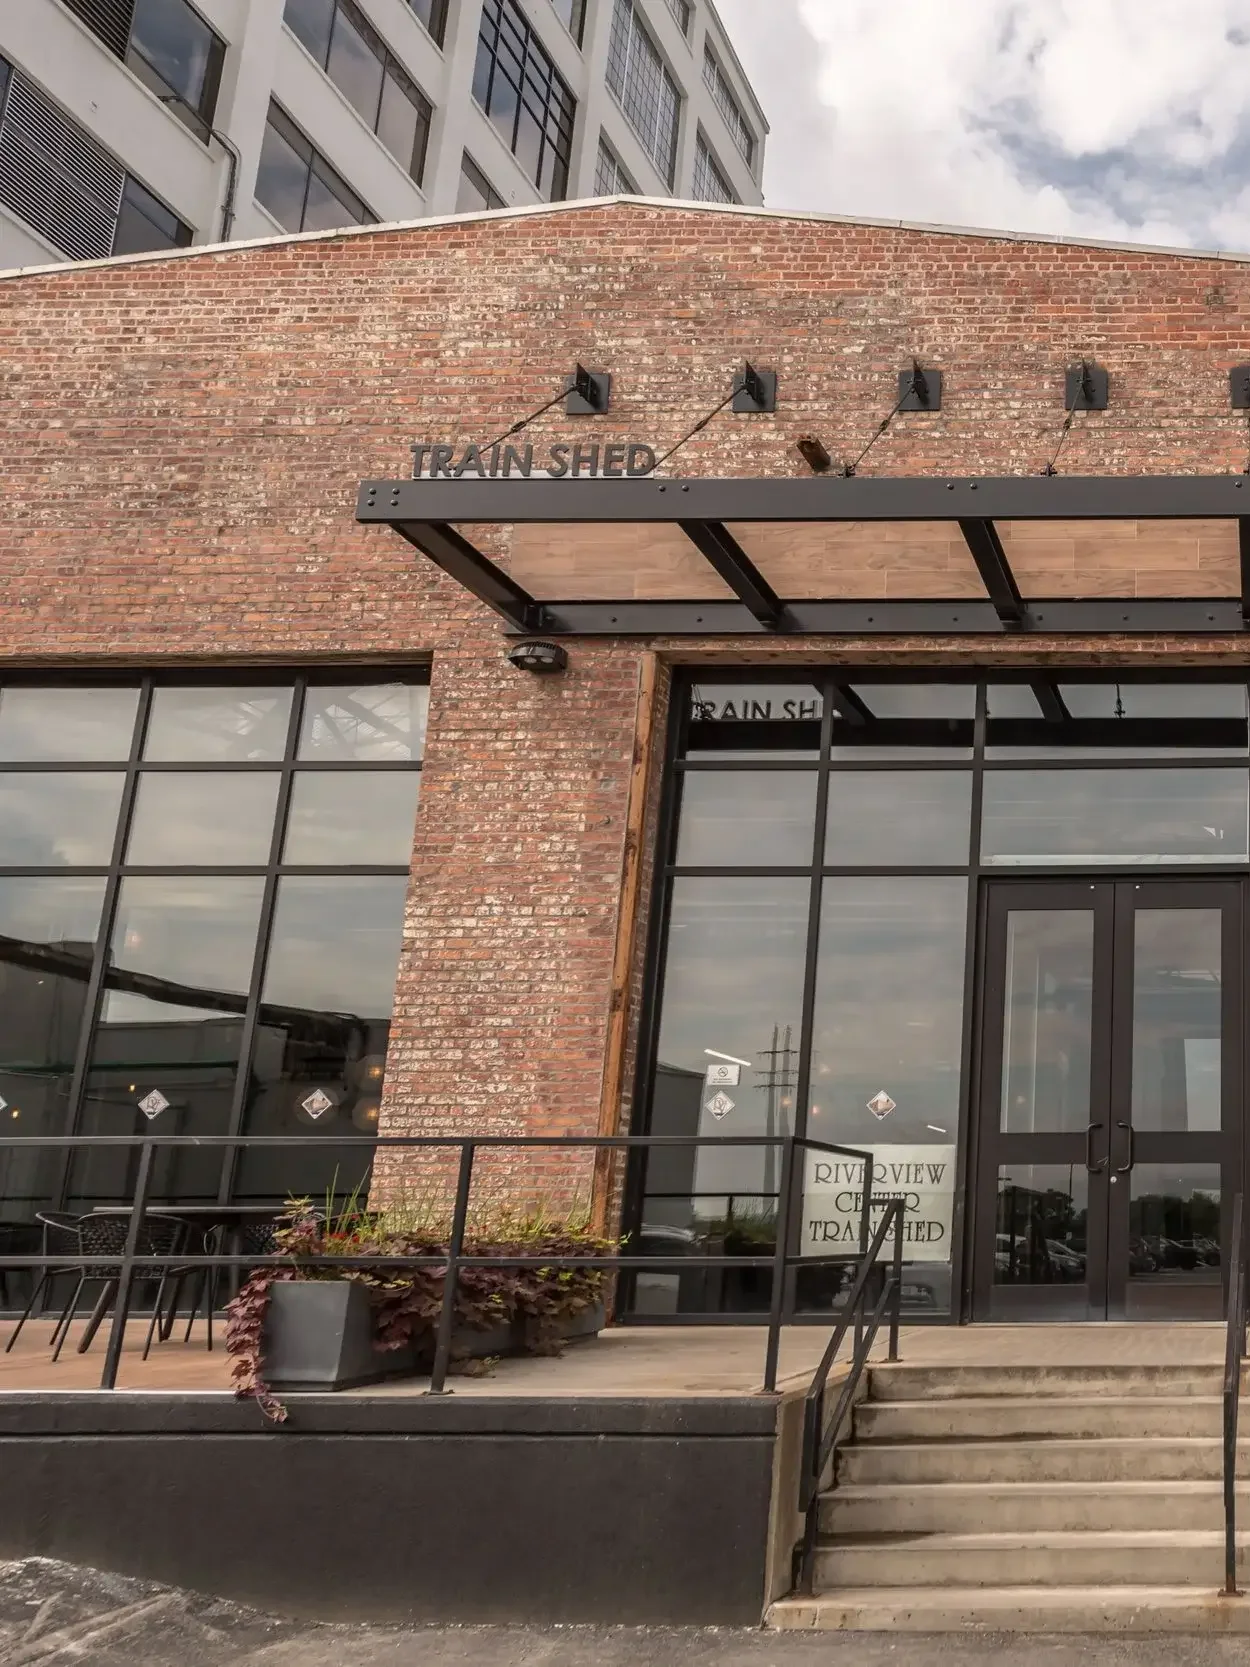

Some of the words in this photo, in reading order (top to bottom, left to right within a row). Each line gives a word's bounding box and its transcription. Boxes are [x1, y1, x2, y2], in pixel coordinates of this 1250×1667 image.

[410, 444, 534, 478] TRAIN
[546, 443, 656, 477] SHED
[809, 1220, 878, 1242] TRAN
